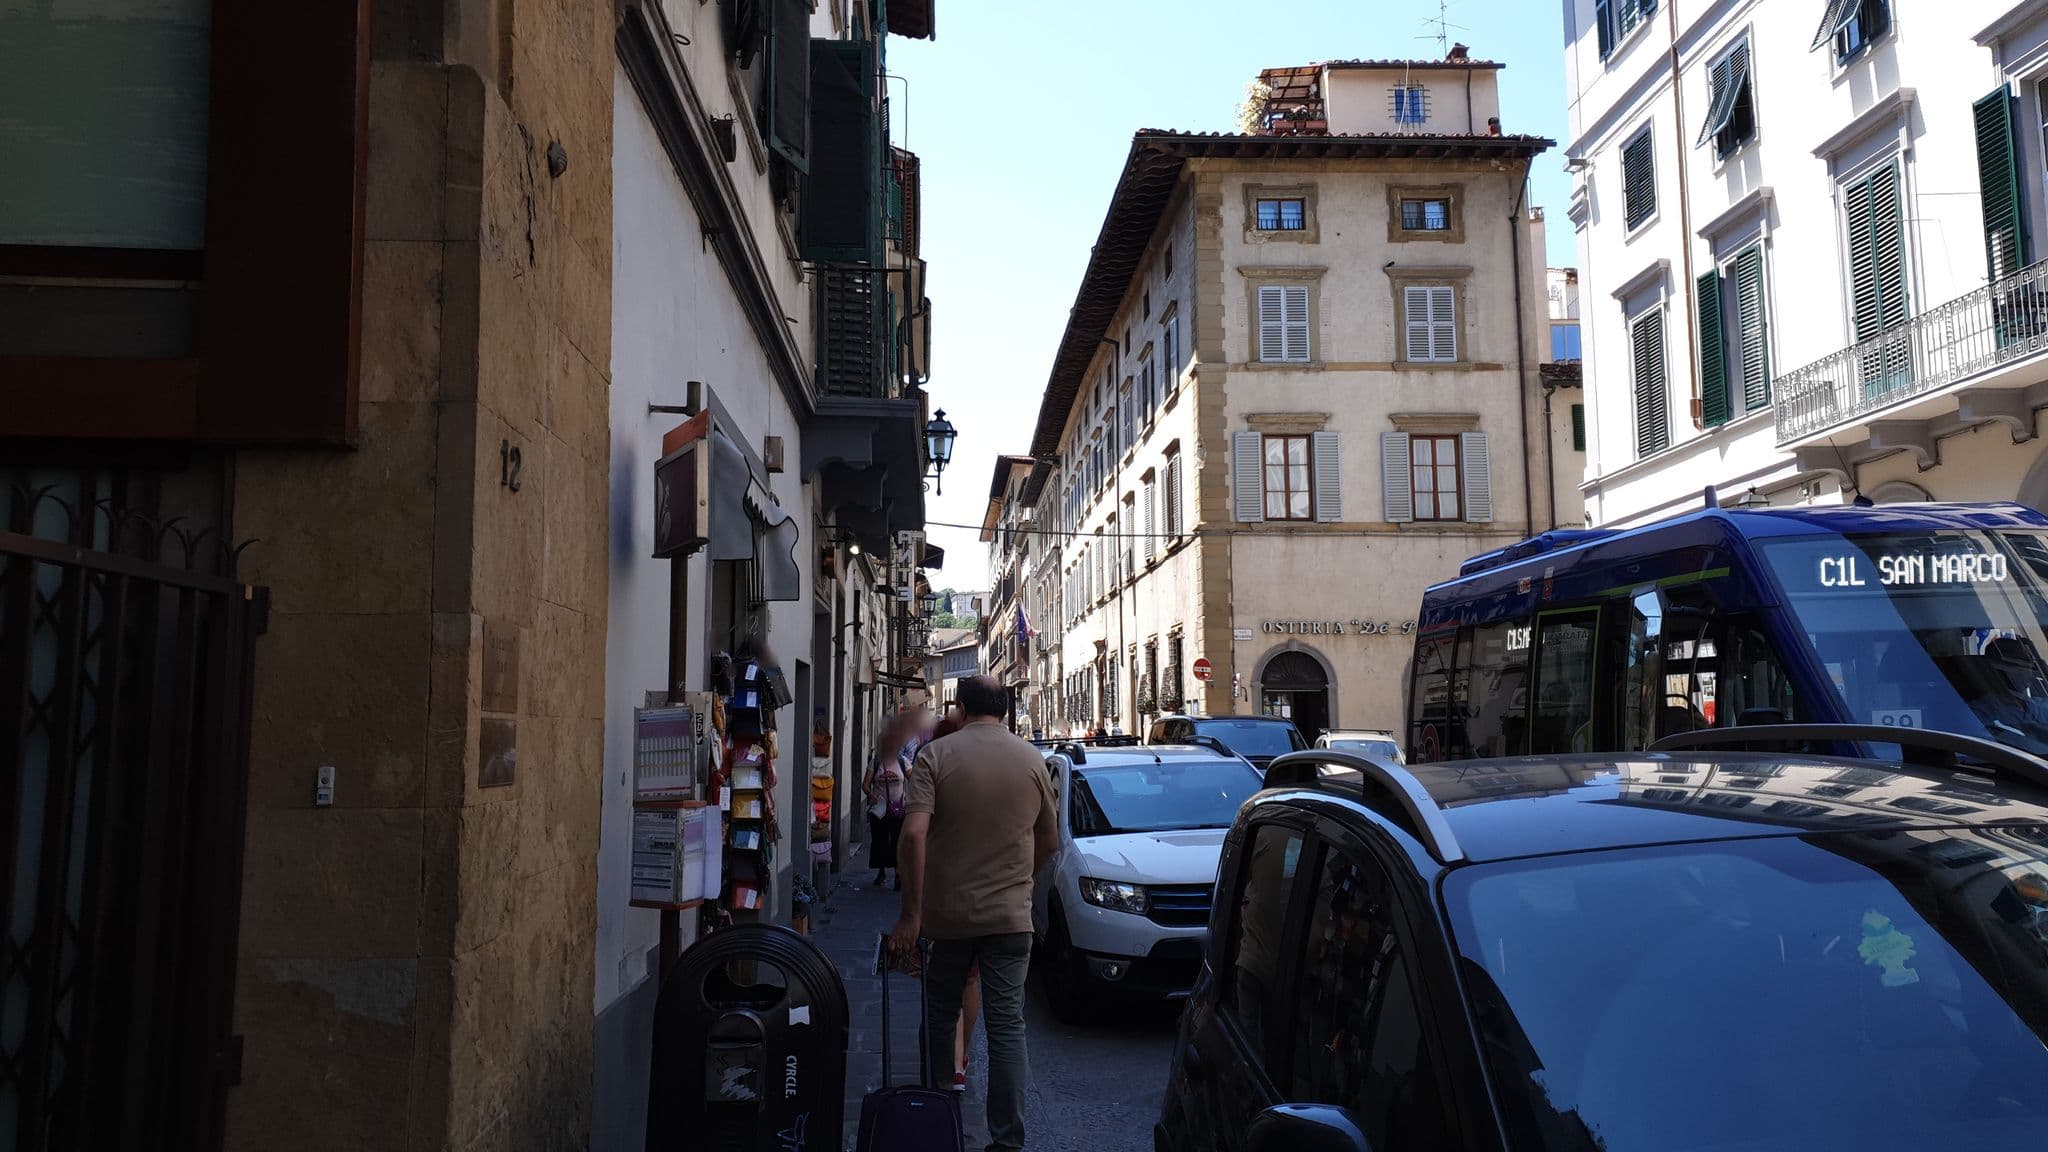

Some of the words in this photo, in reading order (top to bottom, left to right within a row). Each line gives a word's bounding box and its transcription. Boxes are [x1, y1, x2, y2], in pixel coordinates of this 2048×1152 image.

[500, 439, 521, 492] 12
[1820, 556, 1866, 587] C1L
[1879, 555, 1925, 585] SAN
[1932, 553, 2007, 584] MARCO
[1262, 621, 1345, 635] OSTERIA
